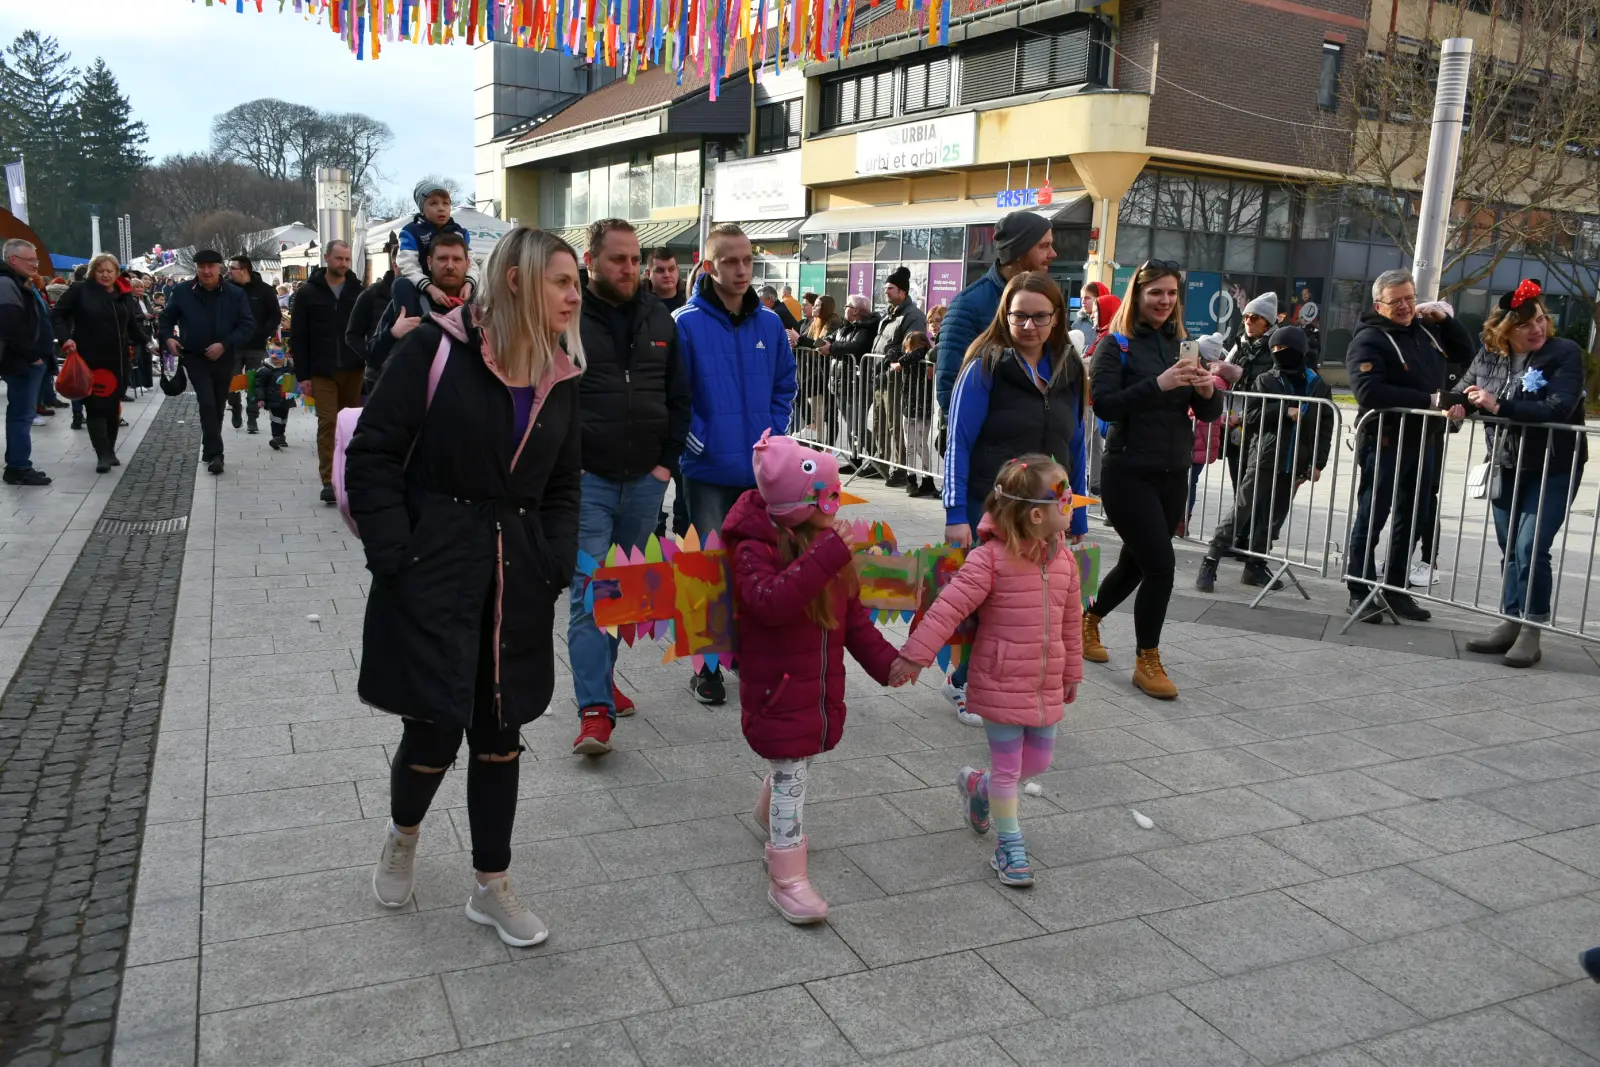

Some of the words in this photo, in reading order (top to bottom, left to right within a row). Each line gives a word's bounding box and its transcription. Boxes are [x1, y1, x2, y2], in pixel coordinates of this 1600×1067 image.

[902, 123, 938, 145] URBIA
[865, 153, 890, 172] urbi
[893, 151, 907, 169] et
[942, 143, 961, 163] 25
[996, 187, 1038, 208] ERSTE
